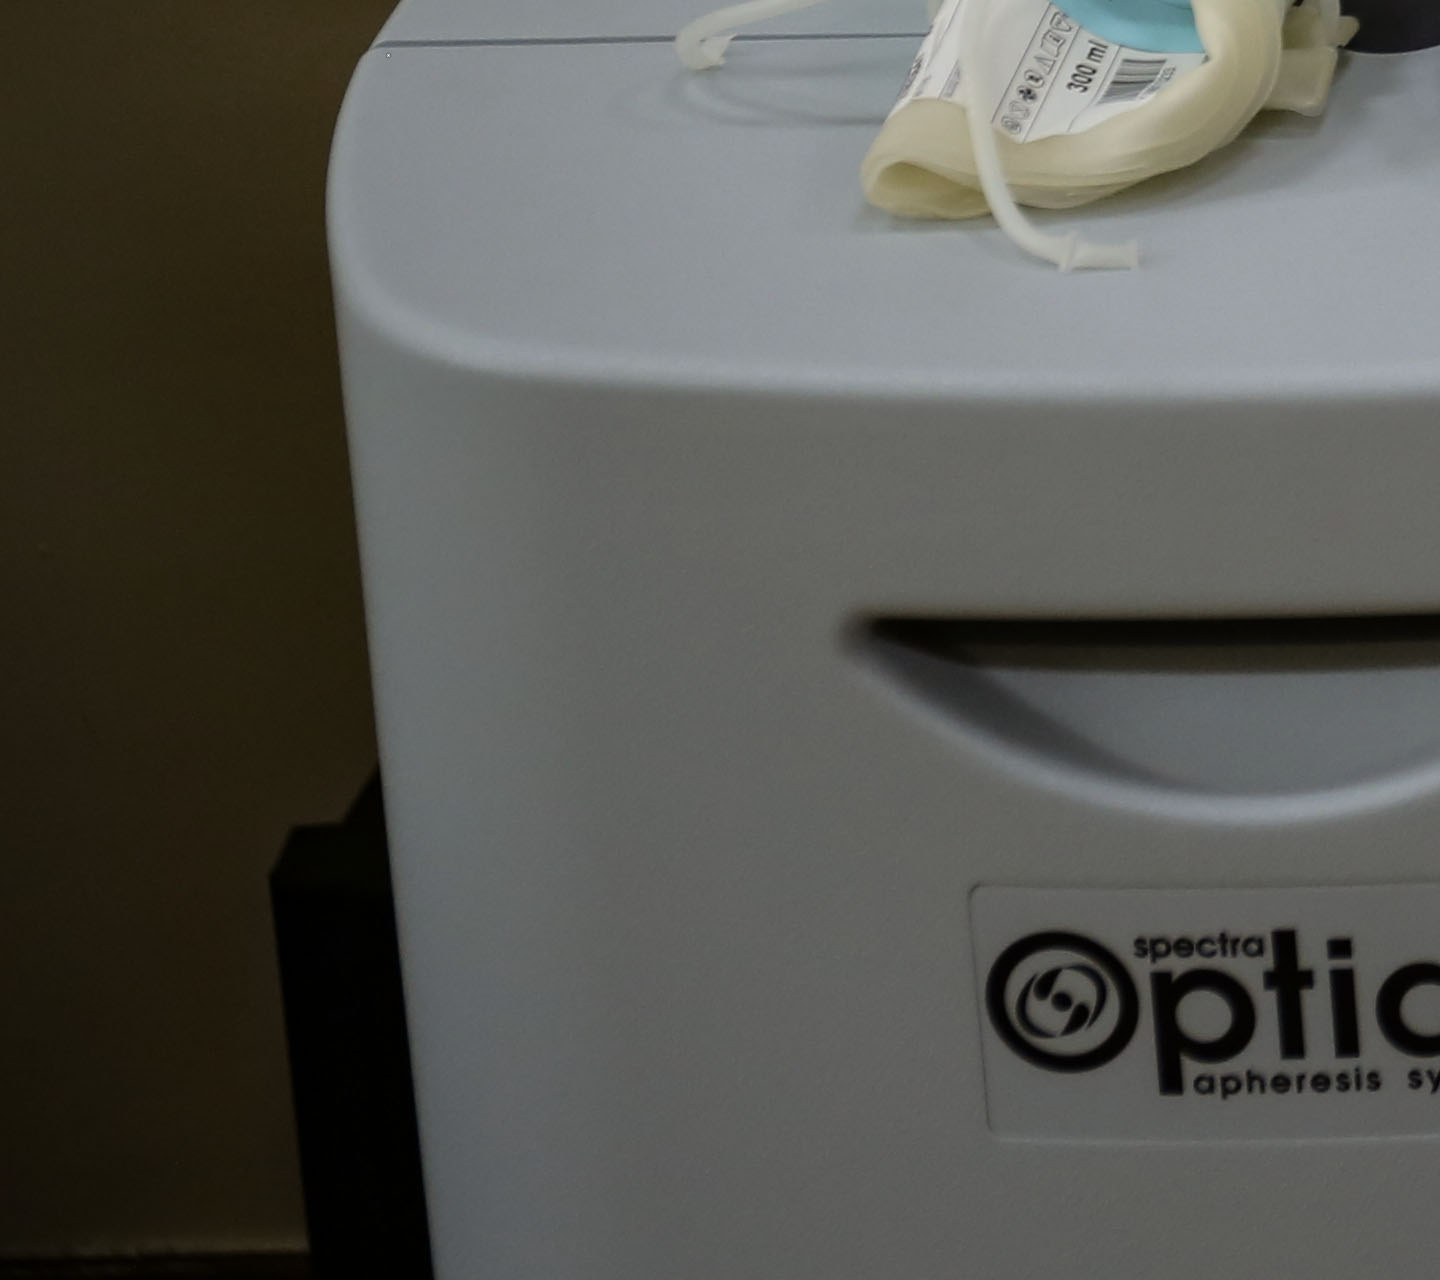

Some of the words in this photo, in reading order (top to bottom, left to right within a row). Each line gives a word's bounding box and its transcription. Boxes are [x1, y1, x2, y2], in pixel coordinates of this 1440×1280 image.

[1066, 64, 1098, 95] 300
[1087, 39, 1109, 66] ml
[1134, 932, 1265, 963] spectra
[1193, 1066, 1381, 1099] apheresis
